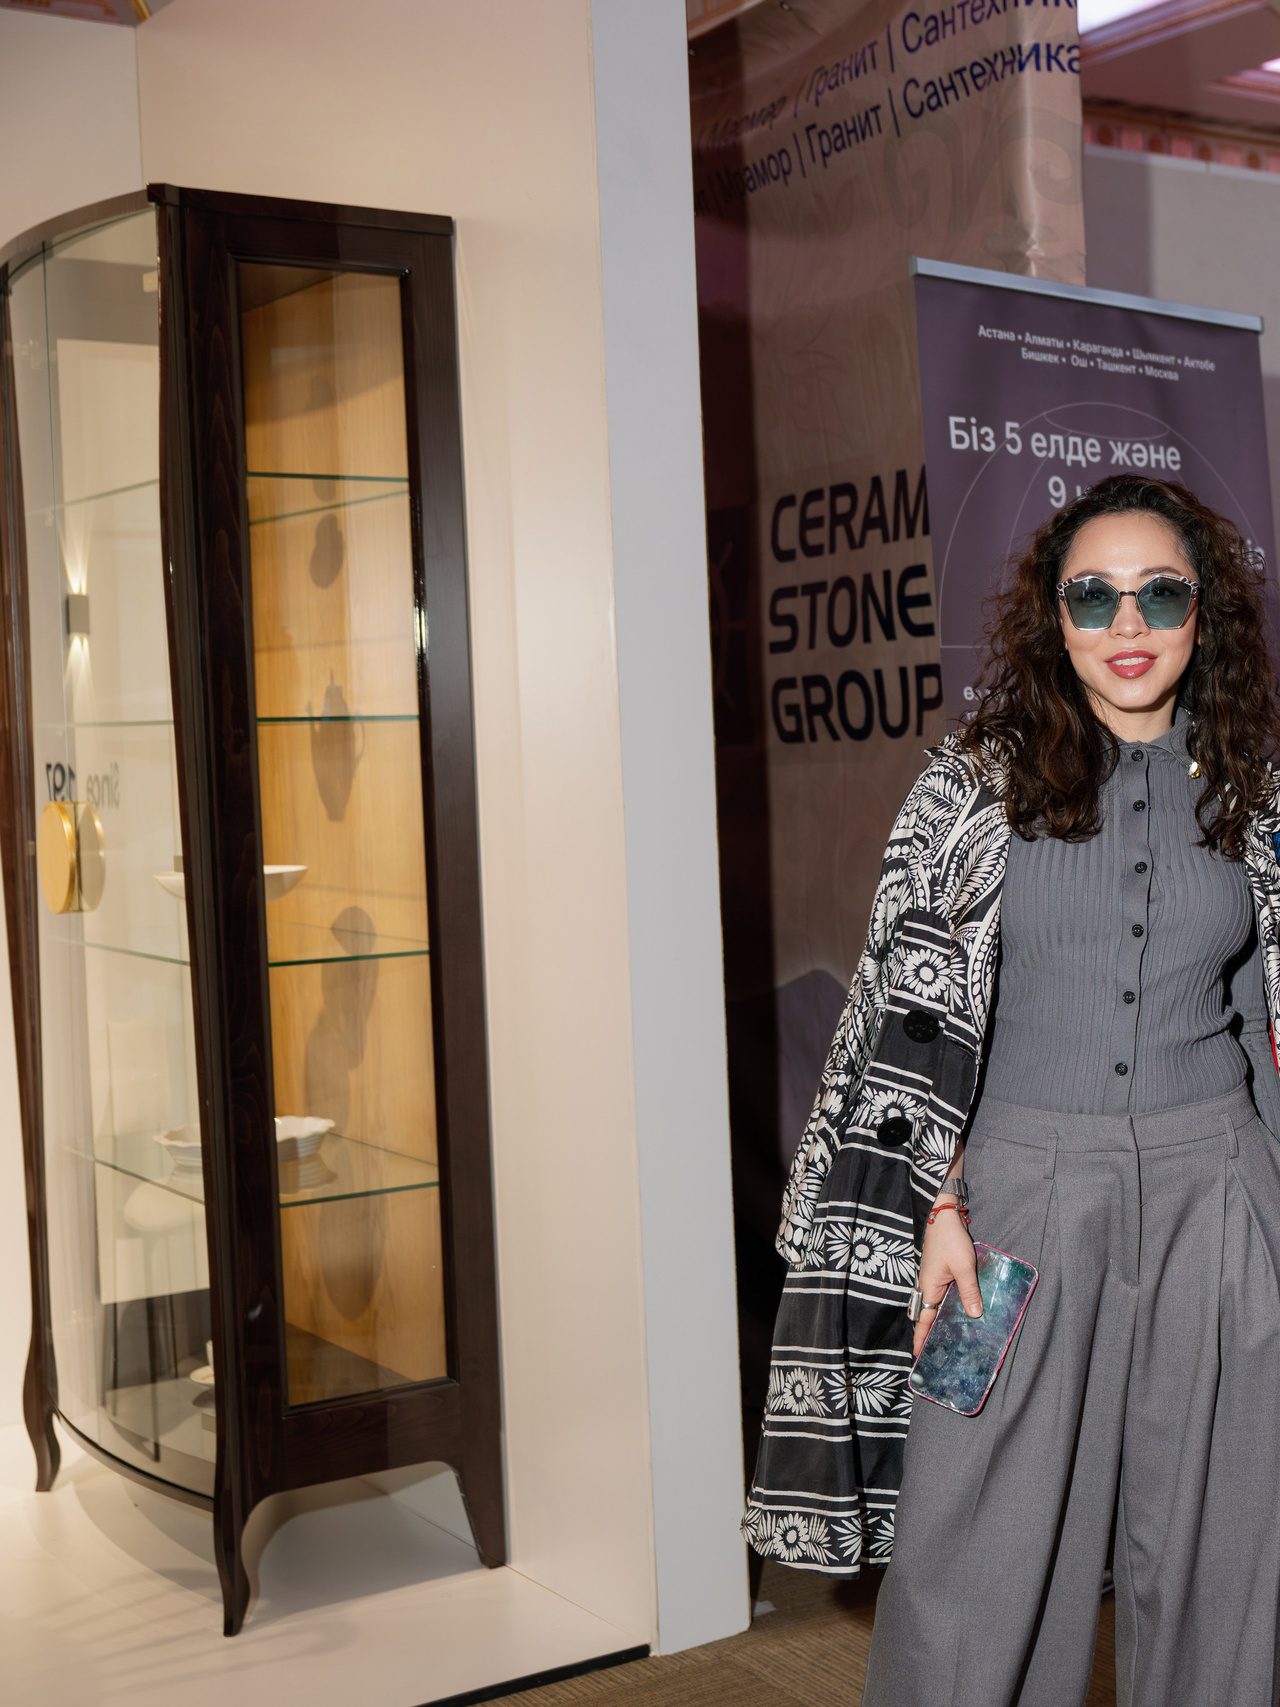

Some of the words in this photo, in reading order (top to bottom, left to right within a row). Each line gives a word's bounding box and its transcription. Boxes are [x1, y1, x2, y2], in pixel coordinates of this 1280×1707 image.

[806, 40, 880, 107] Гранит
[902, 0, 1078, 54] Сантех
[715, 148, 793, 206] Мрамор
[805, 104, 883, 169] Гранит
[902, 43, 1081, 119] Сантехника
[978, 325, 1015, 341] Астана
[1024, 332, 1064, 348] Алматы
[1072, 339, 1123, 358] Караганда
[1131, 348, 1175, 365] Шымкент
[1183, 355, 1216, 371] Актобе
[1021, 347, 1060, 364] Бишкек
[1070, 354, 1088, 368] Ош
[1096, 358, 1136, 374] Ташкент
[1144, 365, 1179, 381] Москва
[948, 415, 997, 453] Біз
[1004, 421, 1023, 456] 5
[1030, 431, 1102, 468] елде
[1109, 440, 1182, 471] және
[1047, 475, 1067, 509] 9
[769, 563, 936, 655] STONE
[771, 663, 944, 744] GROUP
